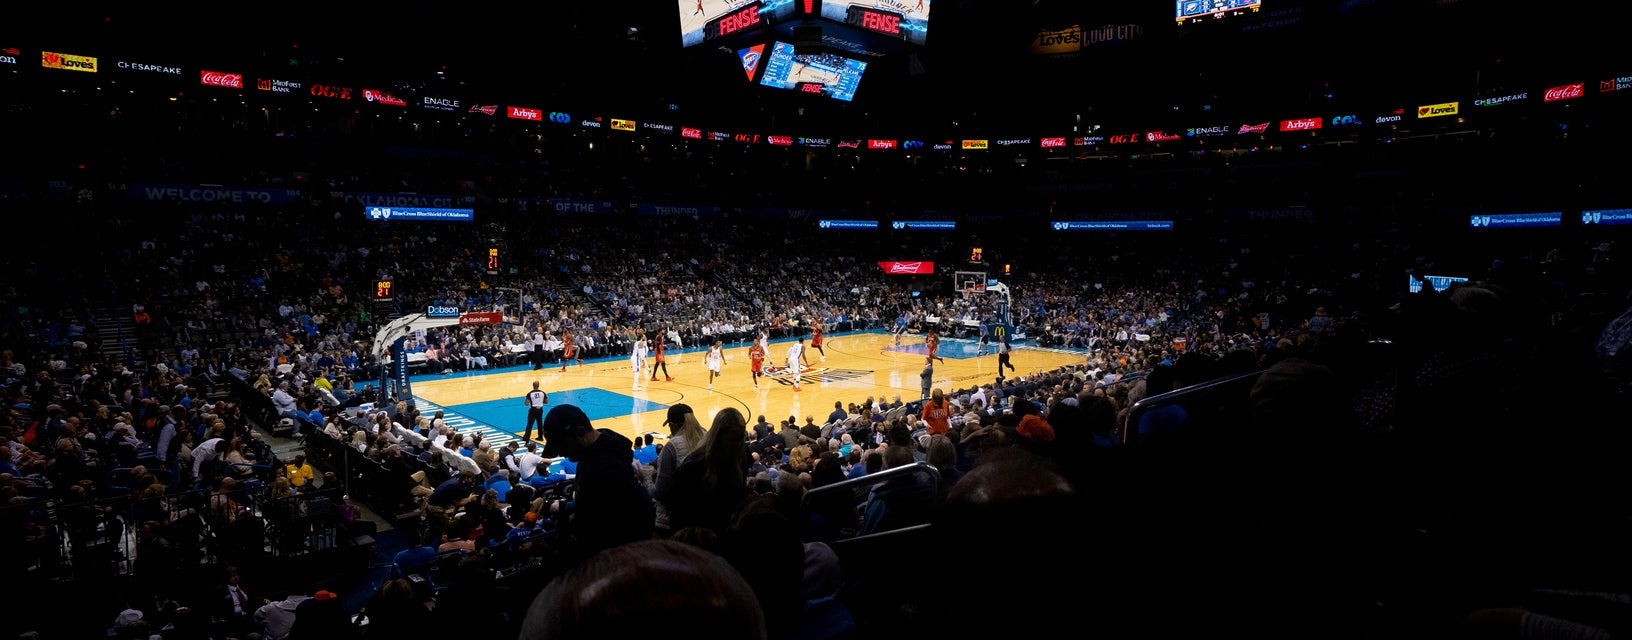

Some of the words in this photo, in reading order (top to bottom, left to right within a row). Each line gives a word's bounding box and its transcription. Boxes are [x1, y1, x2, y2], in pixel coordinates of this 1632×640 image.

[117, 61, 182, 75] CHESAPEAKE
[424, 97, 460, 107] ENABLE
[1474, 92, 1528, 106] CHESAPEAKE
[513, 108, 537, 120] Arby's
[1375, 115, 1401, 124] devon
[1287, 119, 1315, 130] Arby's
[1195, 126, 1230, 135] ENABLE
[735, 133, 761, 144] OGE
[1109, 134, 1140, 144] OGE
[145, 187, 242, 202] WELCOME
[249, 192, 272, 204] TO
[428, 305, 459, 314] Dobson
